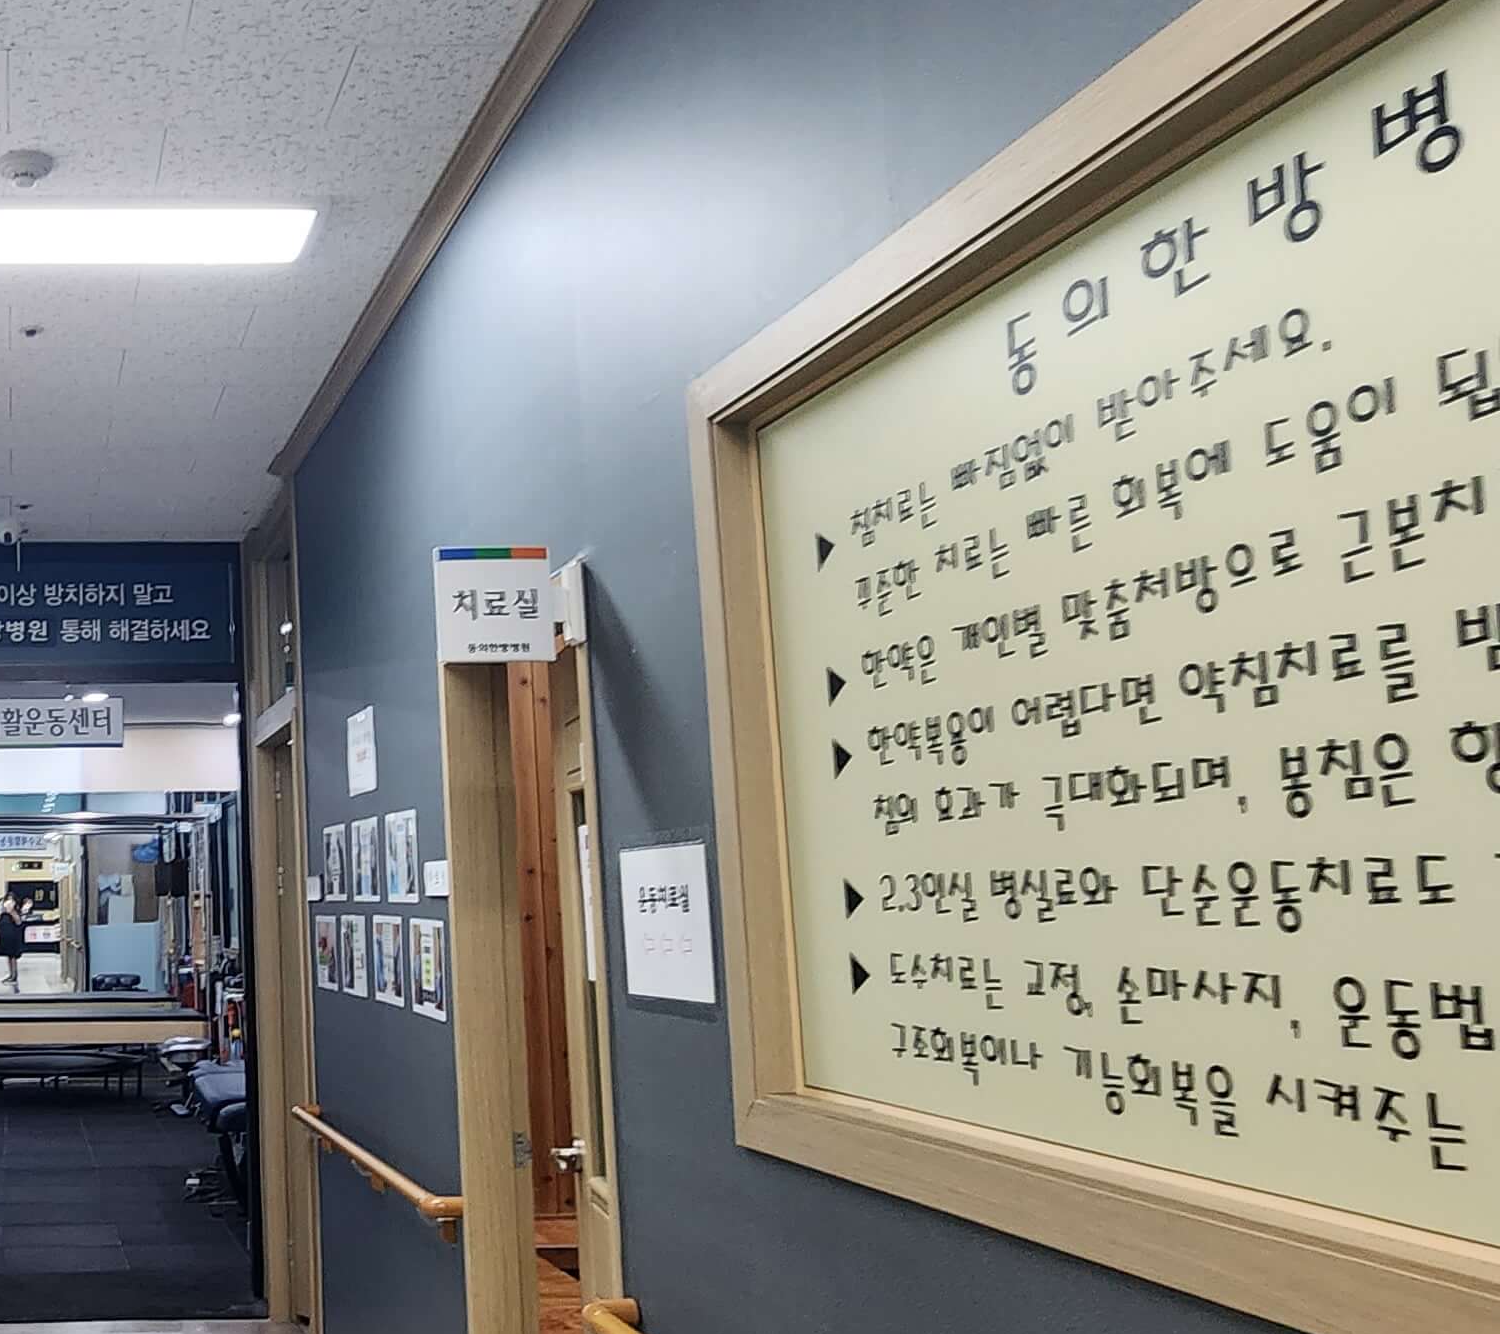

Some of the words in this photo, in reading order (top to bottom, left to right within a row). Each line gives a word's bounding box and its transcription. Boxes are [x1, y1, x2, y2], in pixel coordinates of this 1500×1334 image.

[850, 481, 938, 548] 침치료는
[950, 413, 1075, 491] 빠짐없이
[854, 558, 922, 617] 꾸준한
[934, 526, 1011, 580] 치료는
[1026, 493, 1093, 554] 빠른
[1111, 439, 1232, 521] 회복에
[1263, 376, 1397, 475] 도움이
[44, 583, 125, 607] 방치하지
[133, 582, 174, 606] 말고
[60, 620, 102, 643] 통해
[109, 619, 212, 643] 해결하세요
[451, 588, 541, 621] 치료실
[861, 634, 938, 689] 한약은
[950, 604, 1049, 659] 개인별
[1061, 527, 1304, 642] 맞춤처방으로
[1337, 475, 1486, 584] 근본치
[867, 705, 994, 766] 한약복용이
[1011, 673, 1163, 739] 어렵다면
[1178, 622, 1419, 714] 약침치료를
[873, 793, 918, 836] 침의
[934, 781, 1020, 822] 효과가
[1041, 756, 1248, 832] 극대화되며,
[1279, 733, 1417, 819] 봉침은
[989, 867, 1119, 923] 병실료와
[1142, 856, 1456, 934] 단순운동치료도
[890, 952, 1004, 1010] 도수치료는
[1332, 975, 1496, 1061] 운동법
[890, 1022, 1044, 1087] 구조회복이나
[1062, 1045, 1240, 1138] 기능회복을
[1265, 1073, 1469, 1172] 시켜주는
